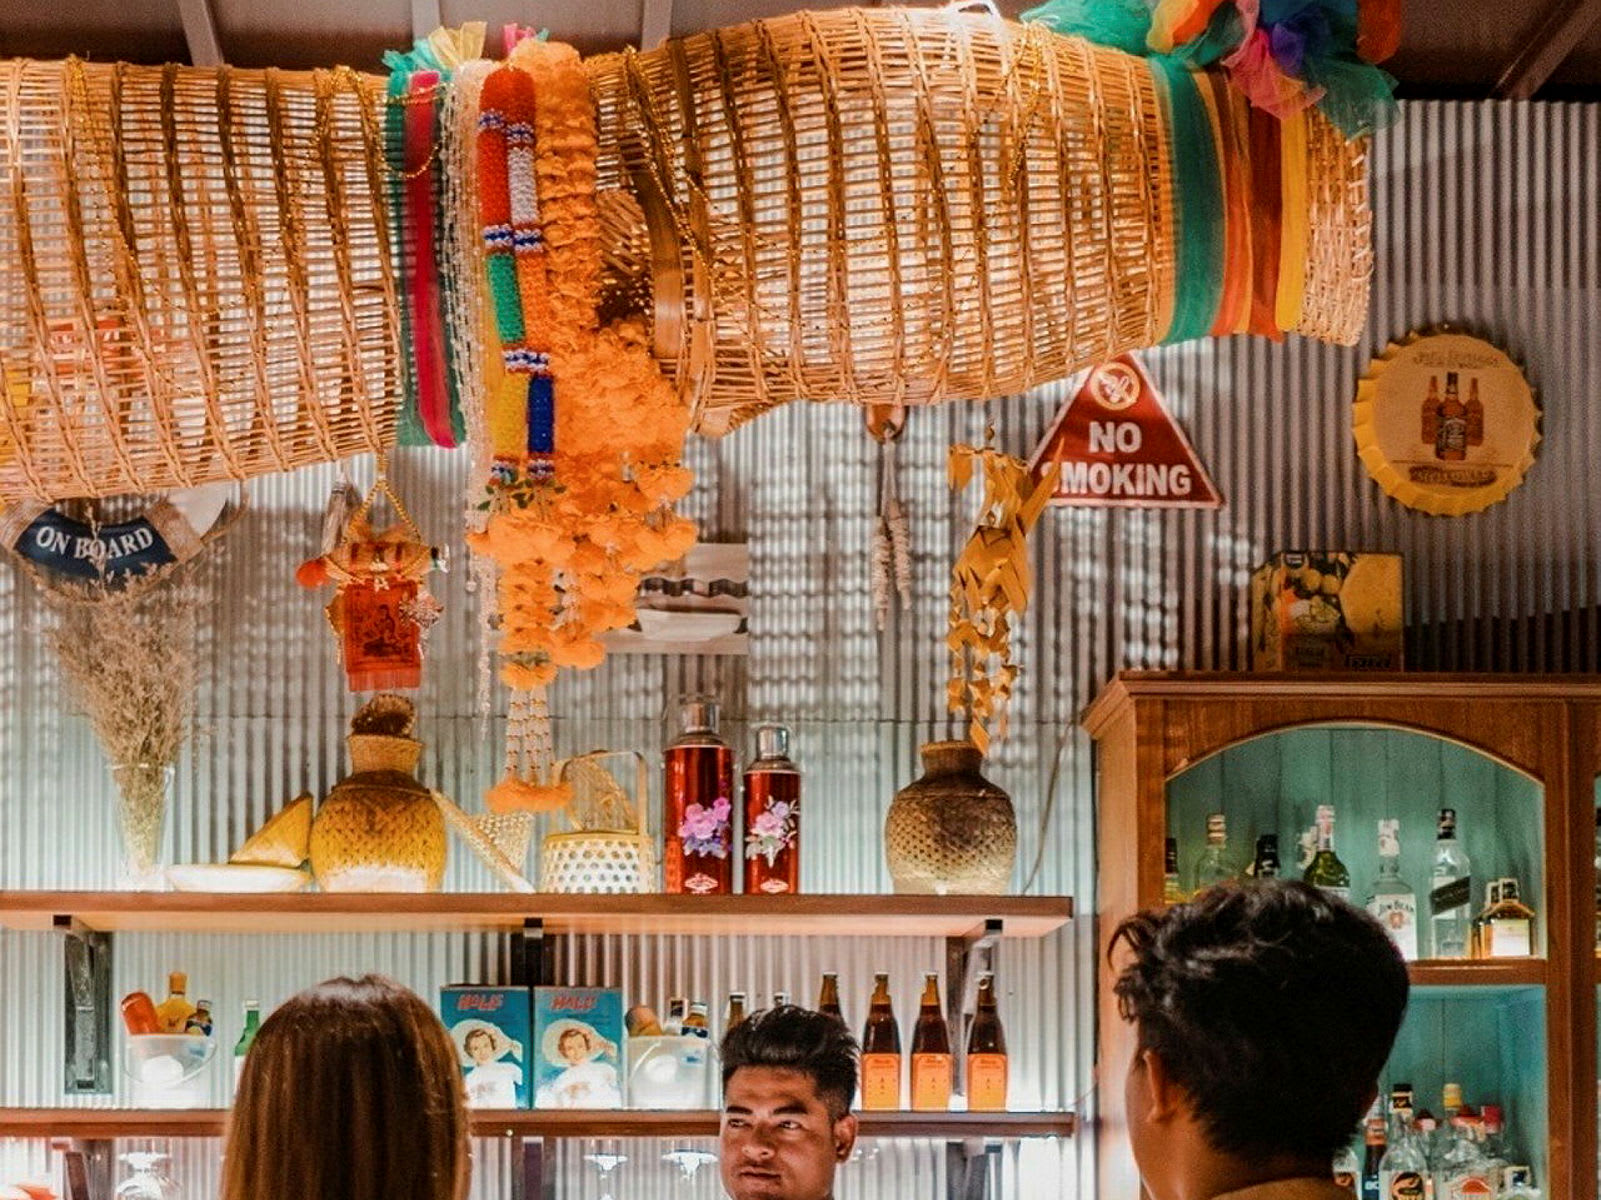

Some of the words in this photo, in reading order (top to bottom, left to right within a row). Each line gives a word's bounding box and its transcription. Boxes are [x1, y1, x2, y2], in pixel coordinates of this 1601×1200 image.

[1088, 420, 1142, 453] NO
[36, 526, 70, 554] ON
[75, 527, 153, 559] BOARD
